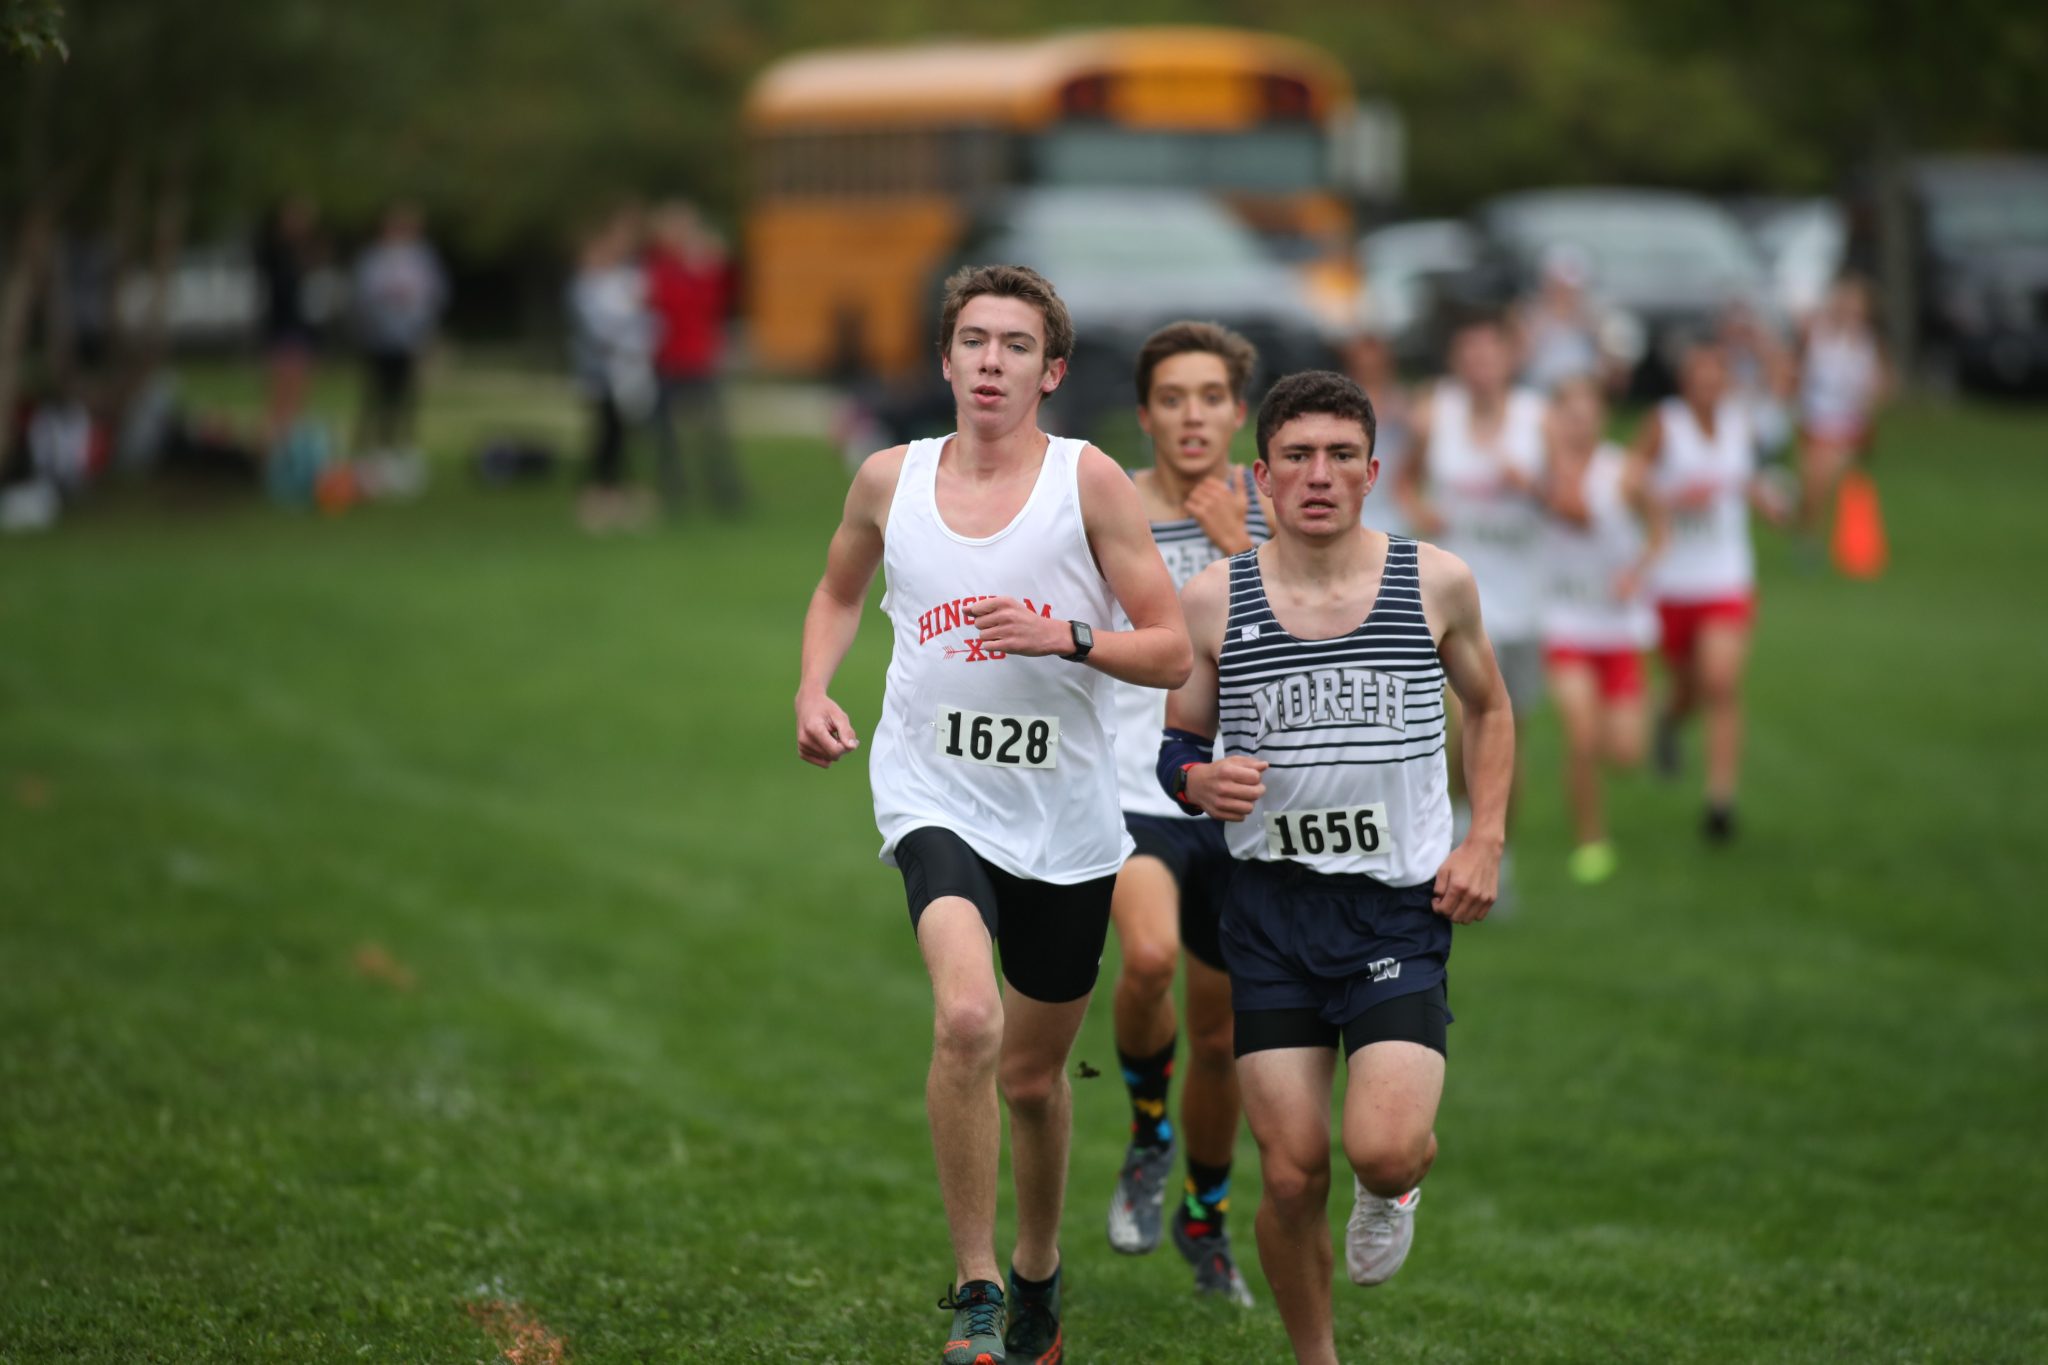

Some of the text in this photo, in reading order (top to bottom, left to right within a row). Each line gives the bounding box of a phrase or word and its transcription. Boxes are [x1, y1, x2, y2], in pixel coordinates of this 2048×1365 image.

[1252, 668, 1408, 743] NORTH
[946, 712, 1049, 764] 1628
[1274, 809, 1380, 856] 1656
